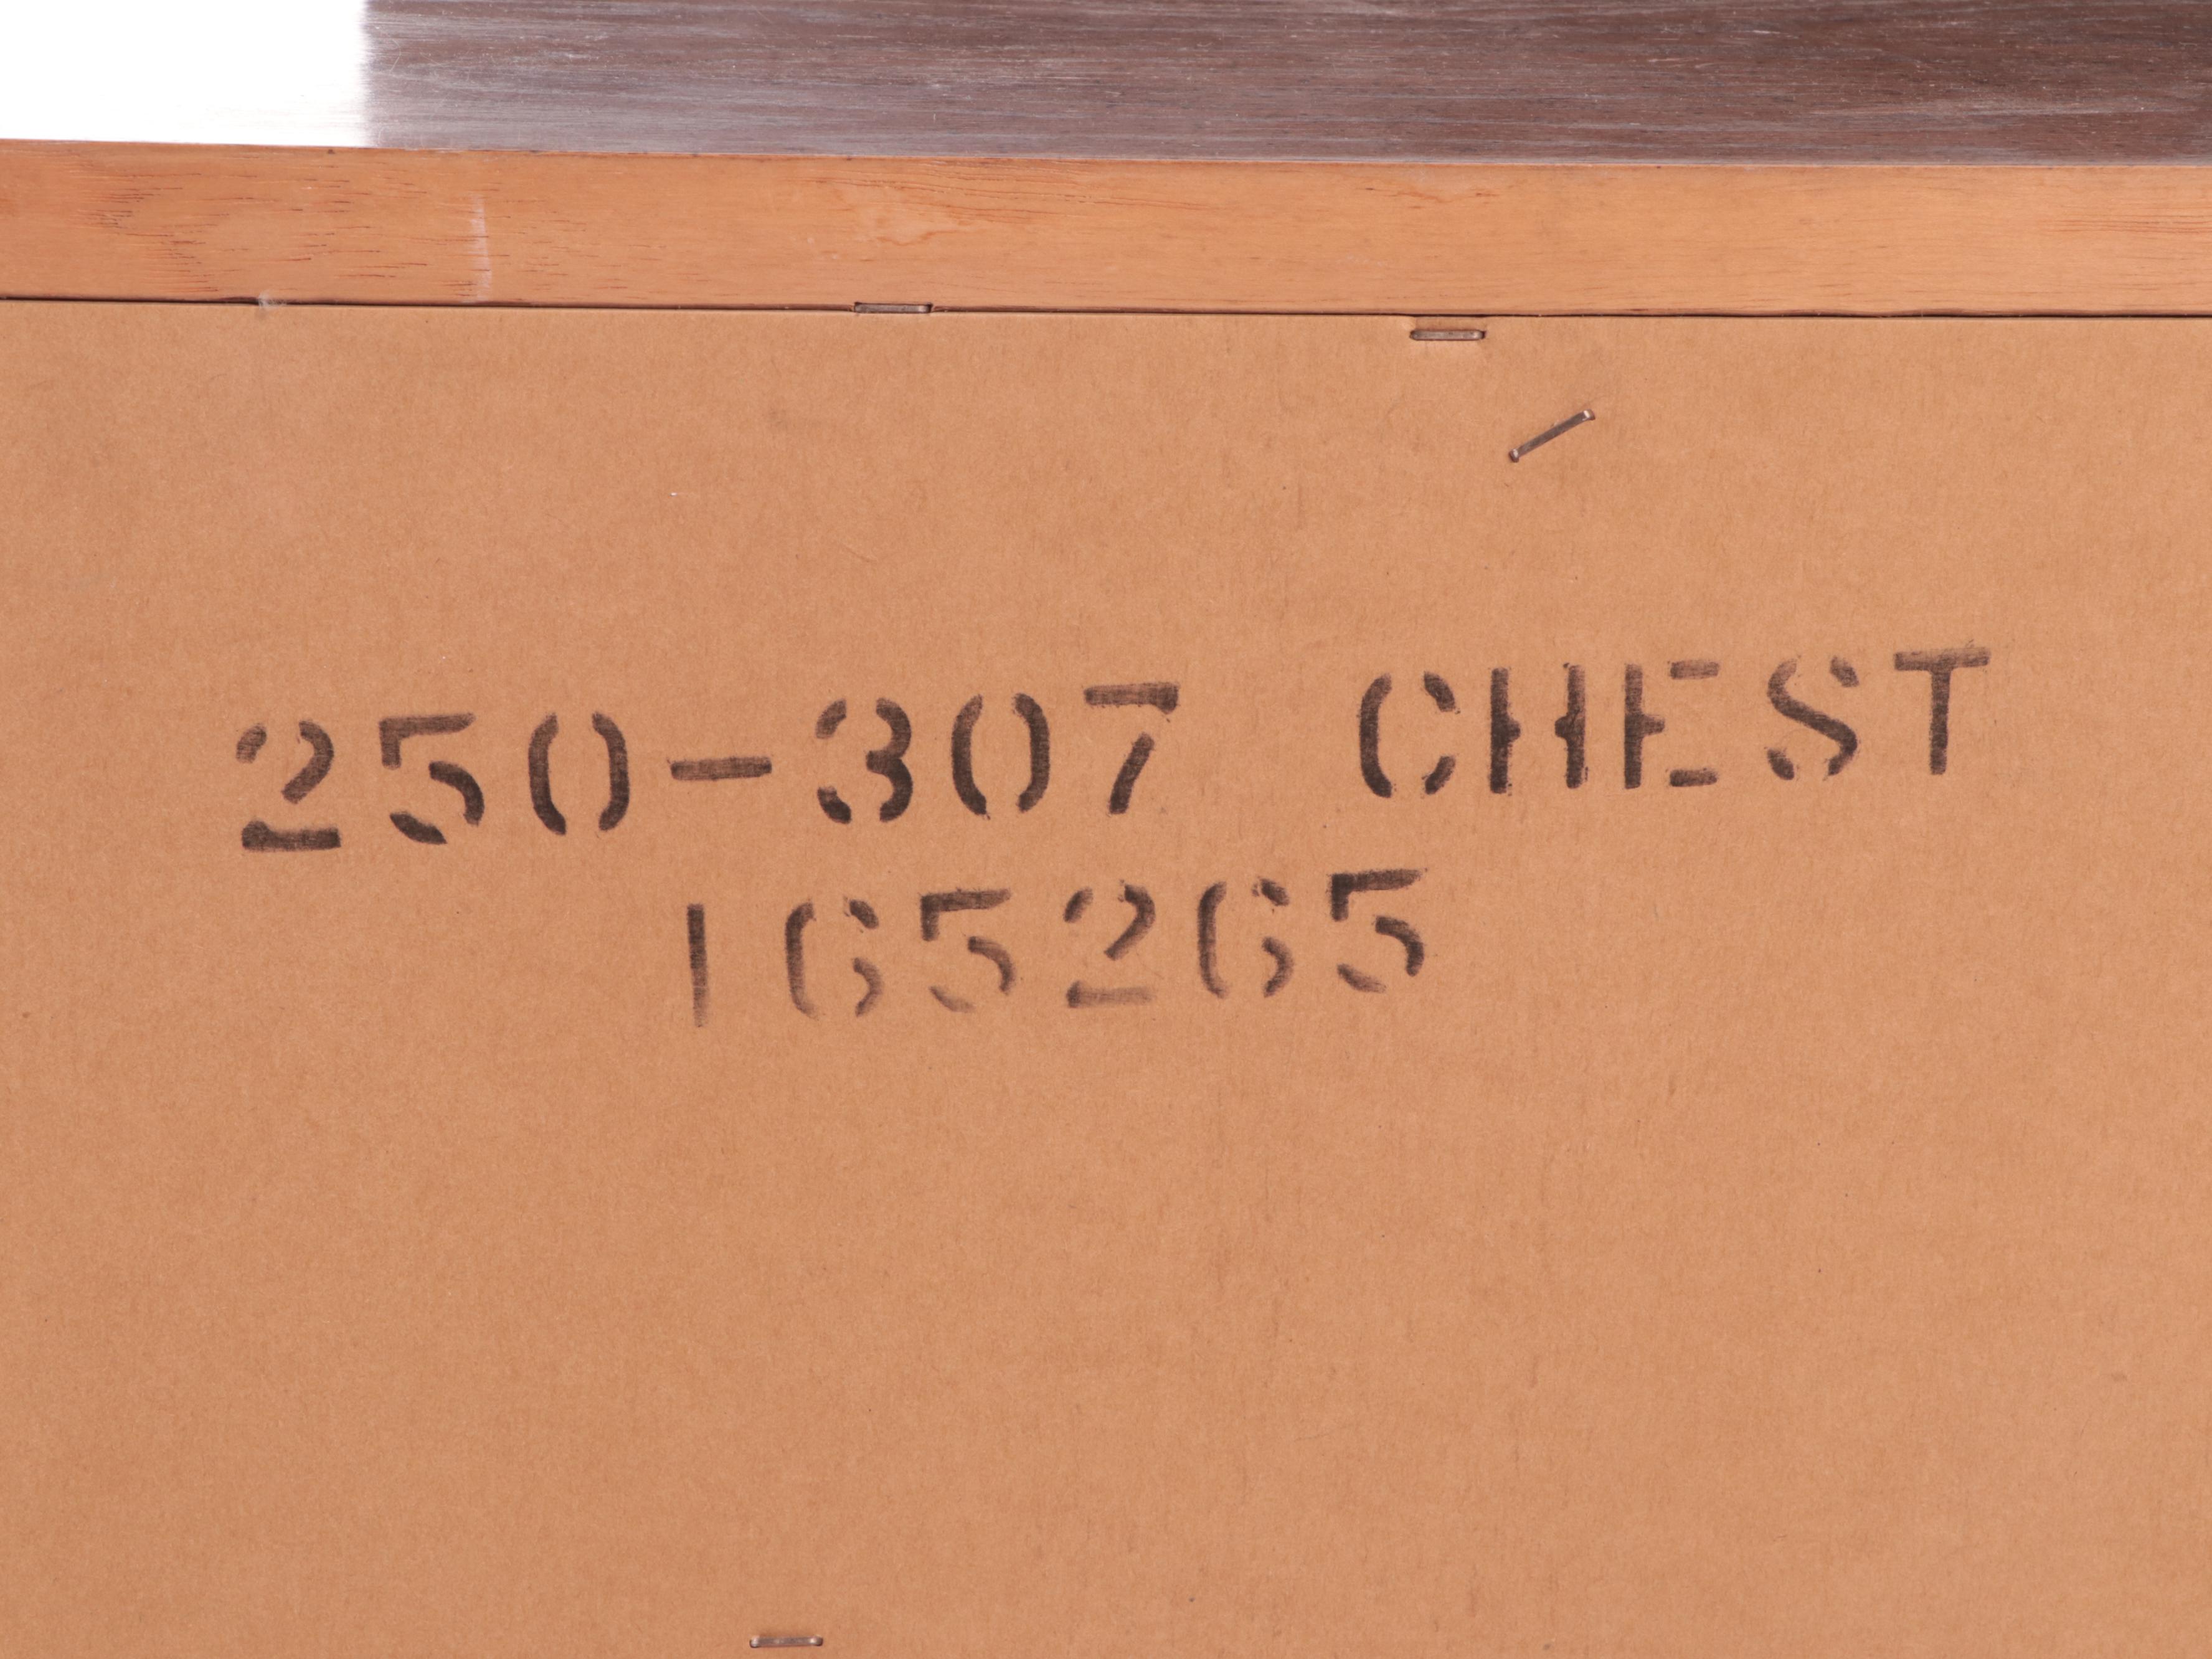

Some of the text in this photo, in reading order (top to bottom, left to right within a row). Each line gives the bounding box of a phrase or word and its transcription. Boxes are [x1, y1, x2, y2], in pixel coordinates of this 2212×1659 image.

[236, 650, 1991, 853] 250-307 CHEST
[686, 868, 1426, 1025] 165265
